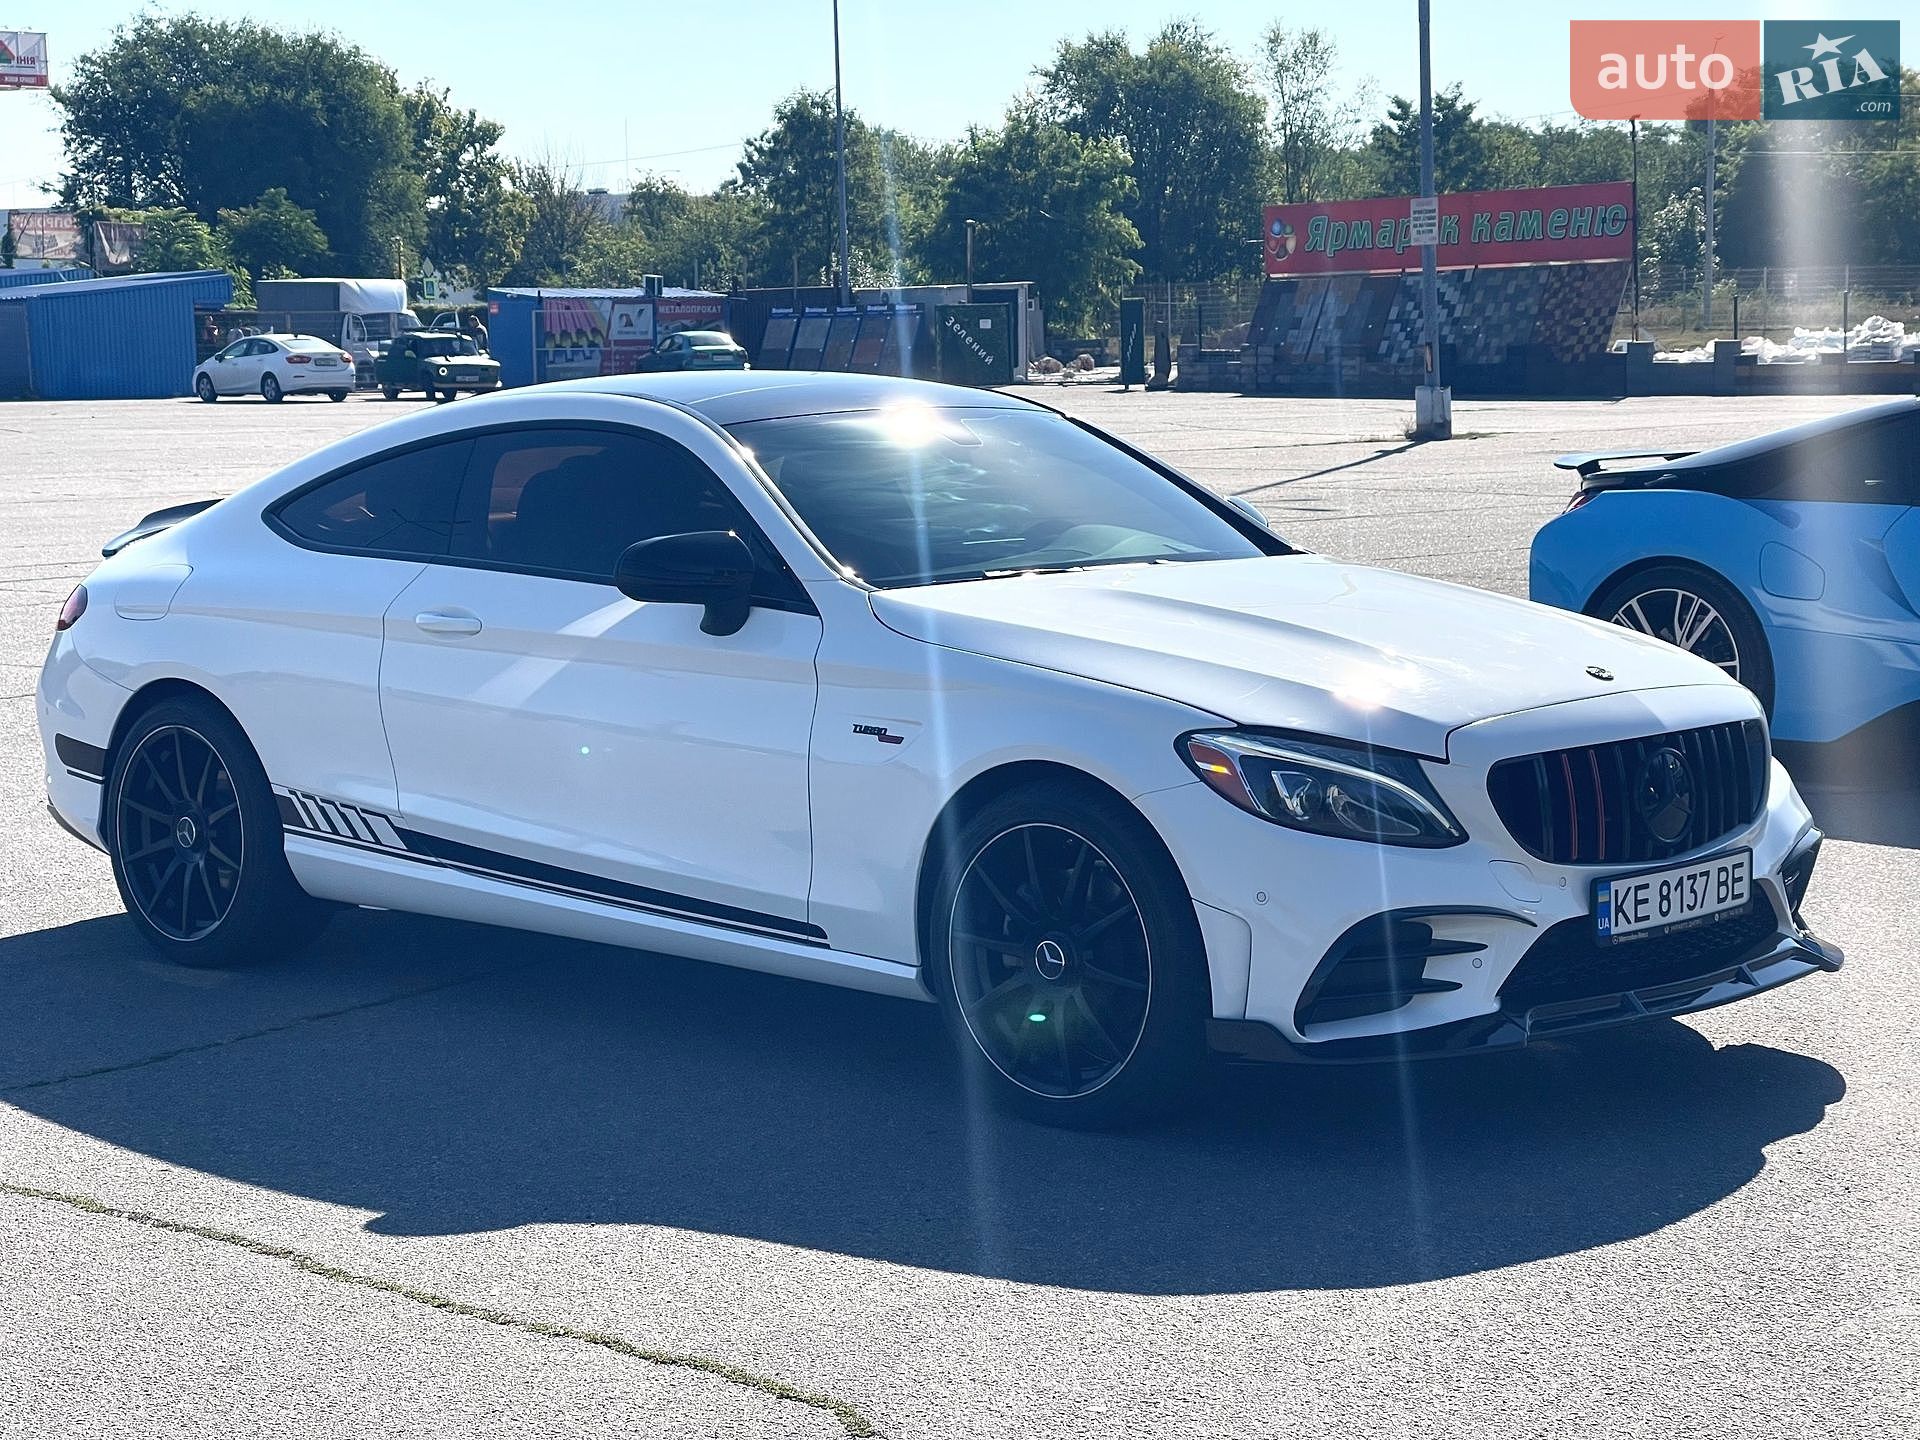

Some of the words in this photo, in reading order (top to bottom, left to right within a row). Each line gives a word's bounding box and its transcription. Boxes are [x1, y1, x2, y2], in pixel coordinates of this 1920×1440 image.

[1305, 213, 1458, 257] Ярмарк
[945, 316, 994, 366] Зелений
[1614, 882, 1651, 927] KE
[1658, 870, 1711, 918] 8137
[1716, 861, 1745, 904] BE
[1597, 917, 1610, 930] UA
